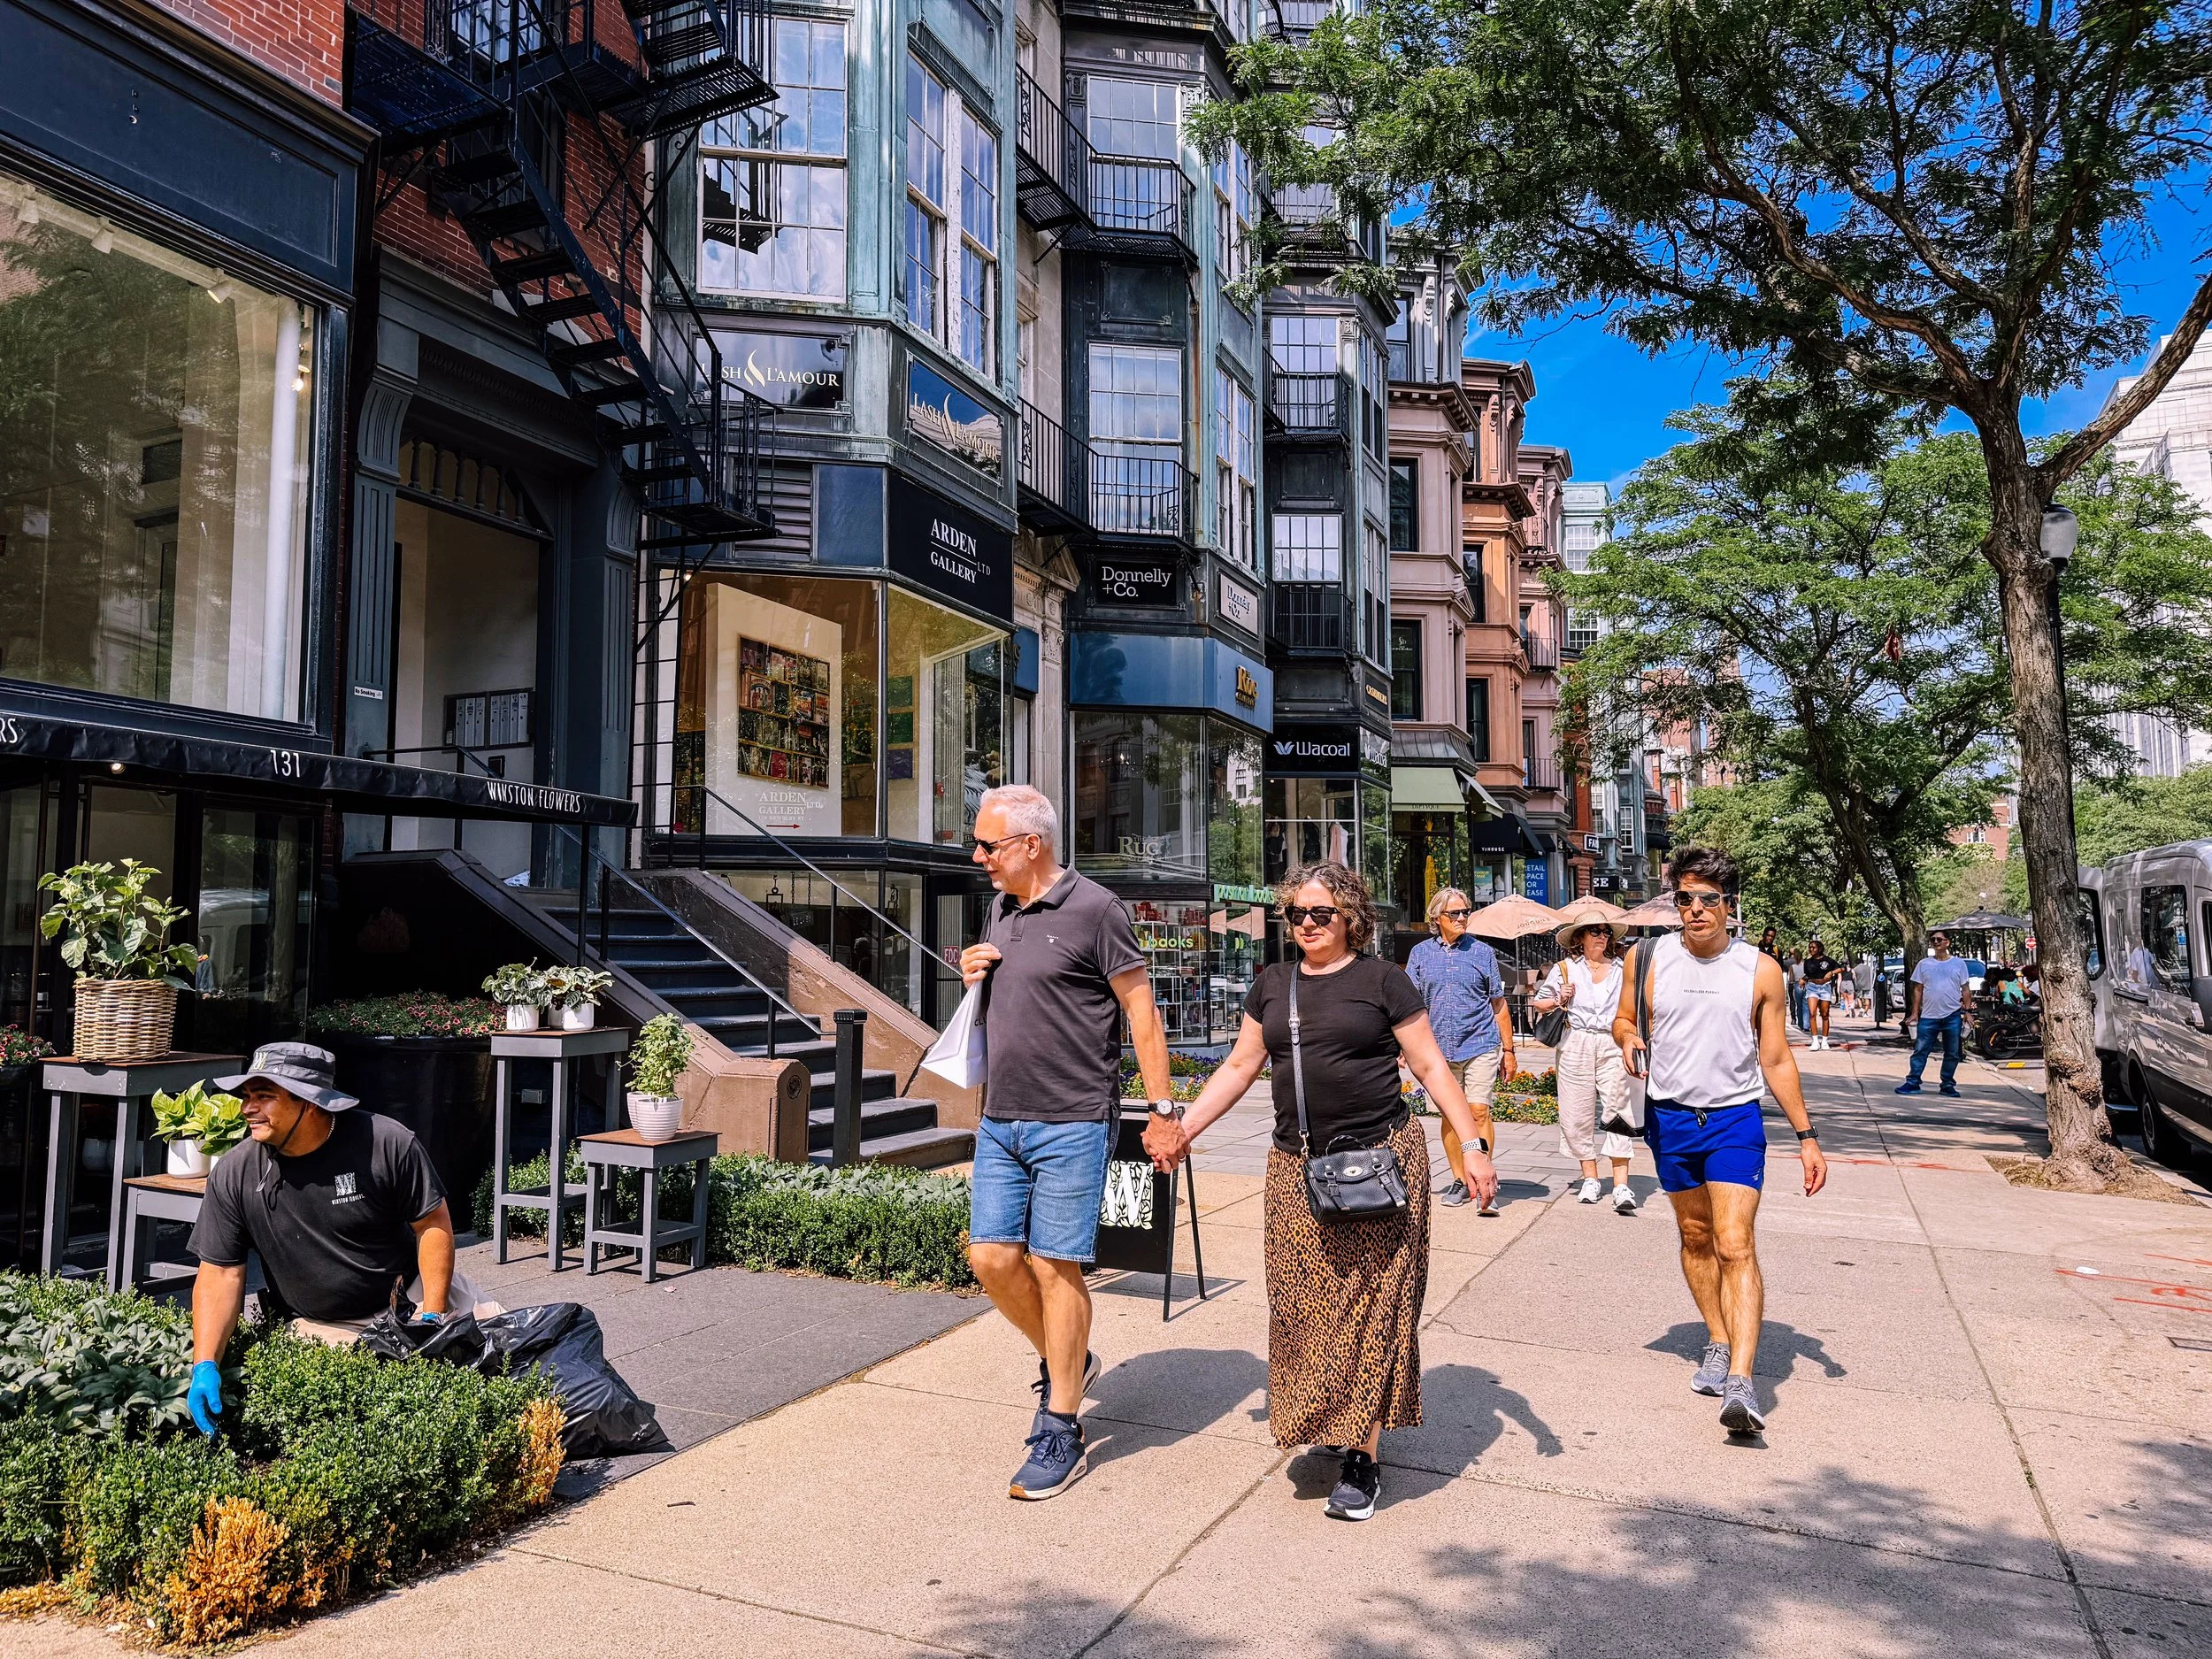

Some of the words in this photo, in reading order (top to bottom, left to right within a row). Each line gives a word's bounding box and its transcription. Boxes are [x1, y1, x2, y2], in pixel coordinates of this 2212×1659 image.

[701, 364, 741, 379] LSH
[767, 367, 840, 387] L'AMOUR
[914, 392, 941, 427] LASH
[956, 420, 1000, 464] L'AMOUR
[931, 518, 977, 557] ARDEN
[930, 551, 977, 584] GALLERY
[977, 561, 991, 576] LTD
[1102, 566, 1172, 588] Donnelly
[1102, 581, 1139, 597] +Co.
[1296, 741, 1350, 757] Wacoal
[270, 749, 300, 778] 131
[487, 781, 534, 807] WINSTON
[539, 789, 580, 813] FLOWERS
[758, 792, 806, 803] ARDEN
[758, 806, 806, 815] GALLERY
[1147, 935, 1194, 949] books
[945, 948, 958, 963] FDC
